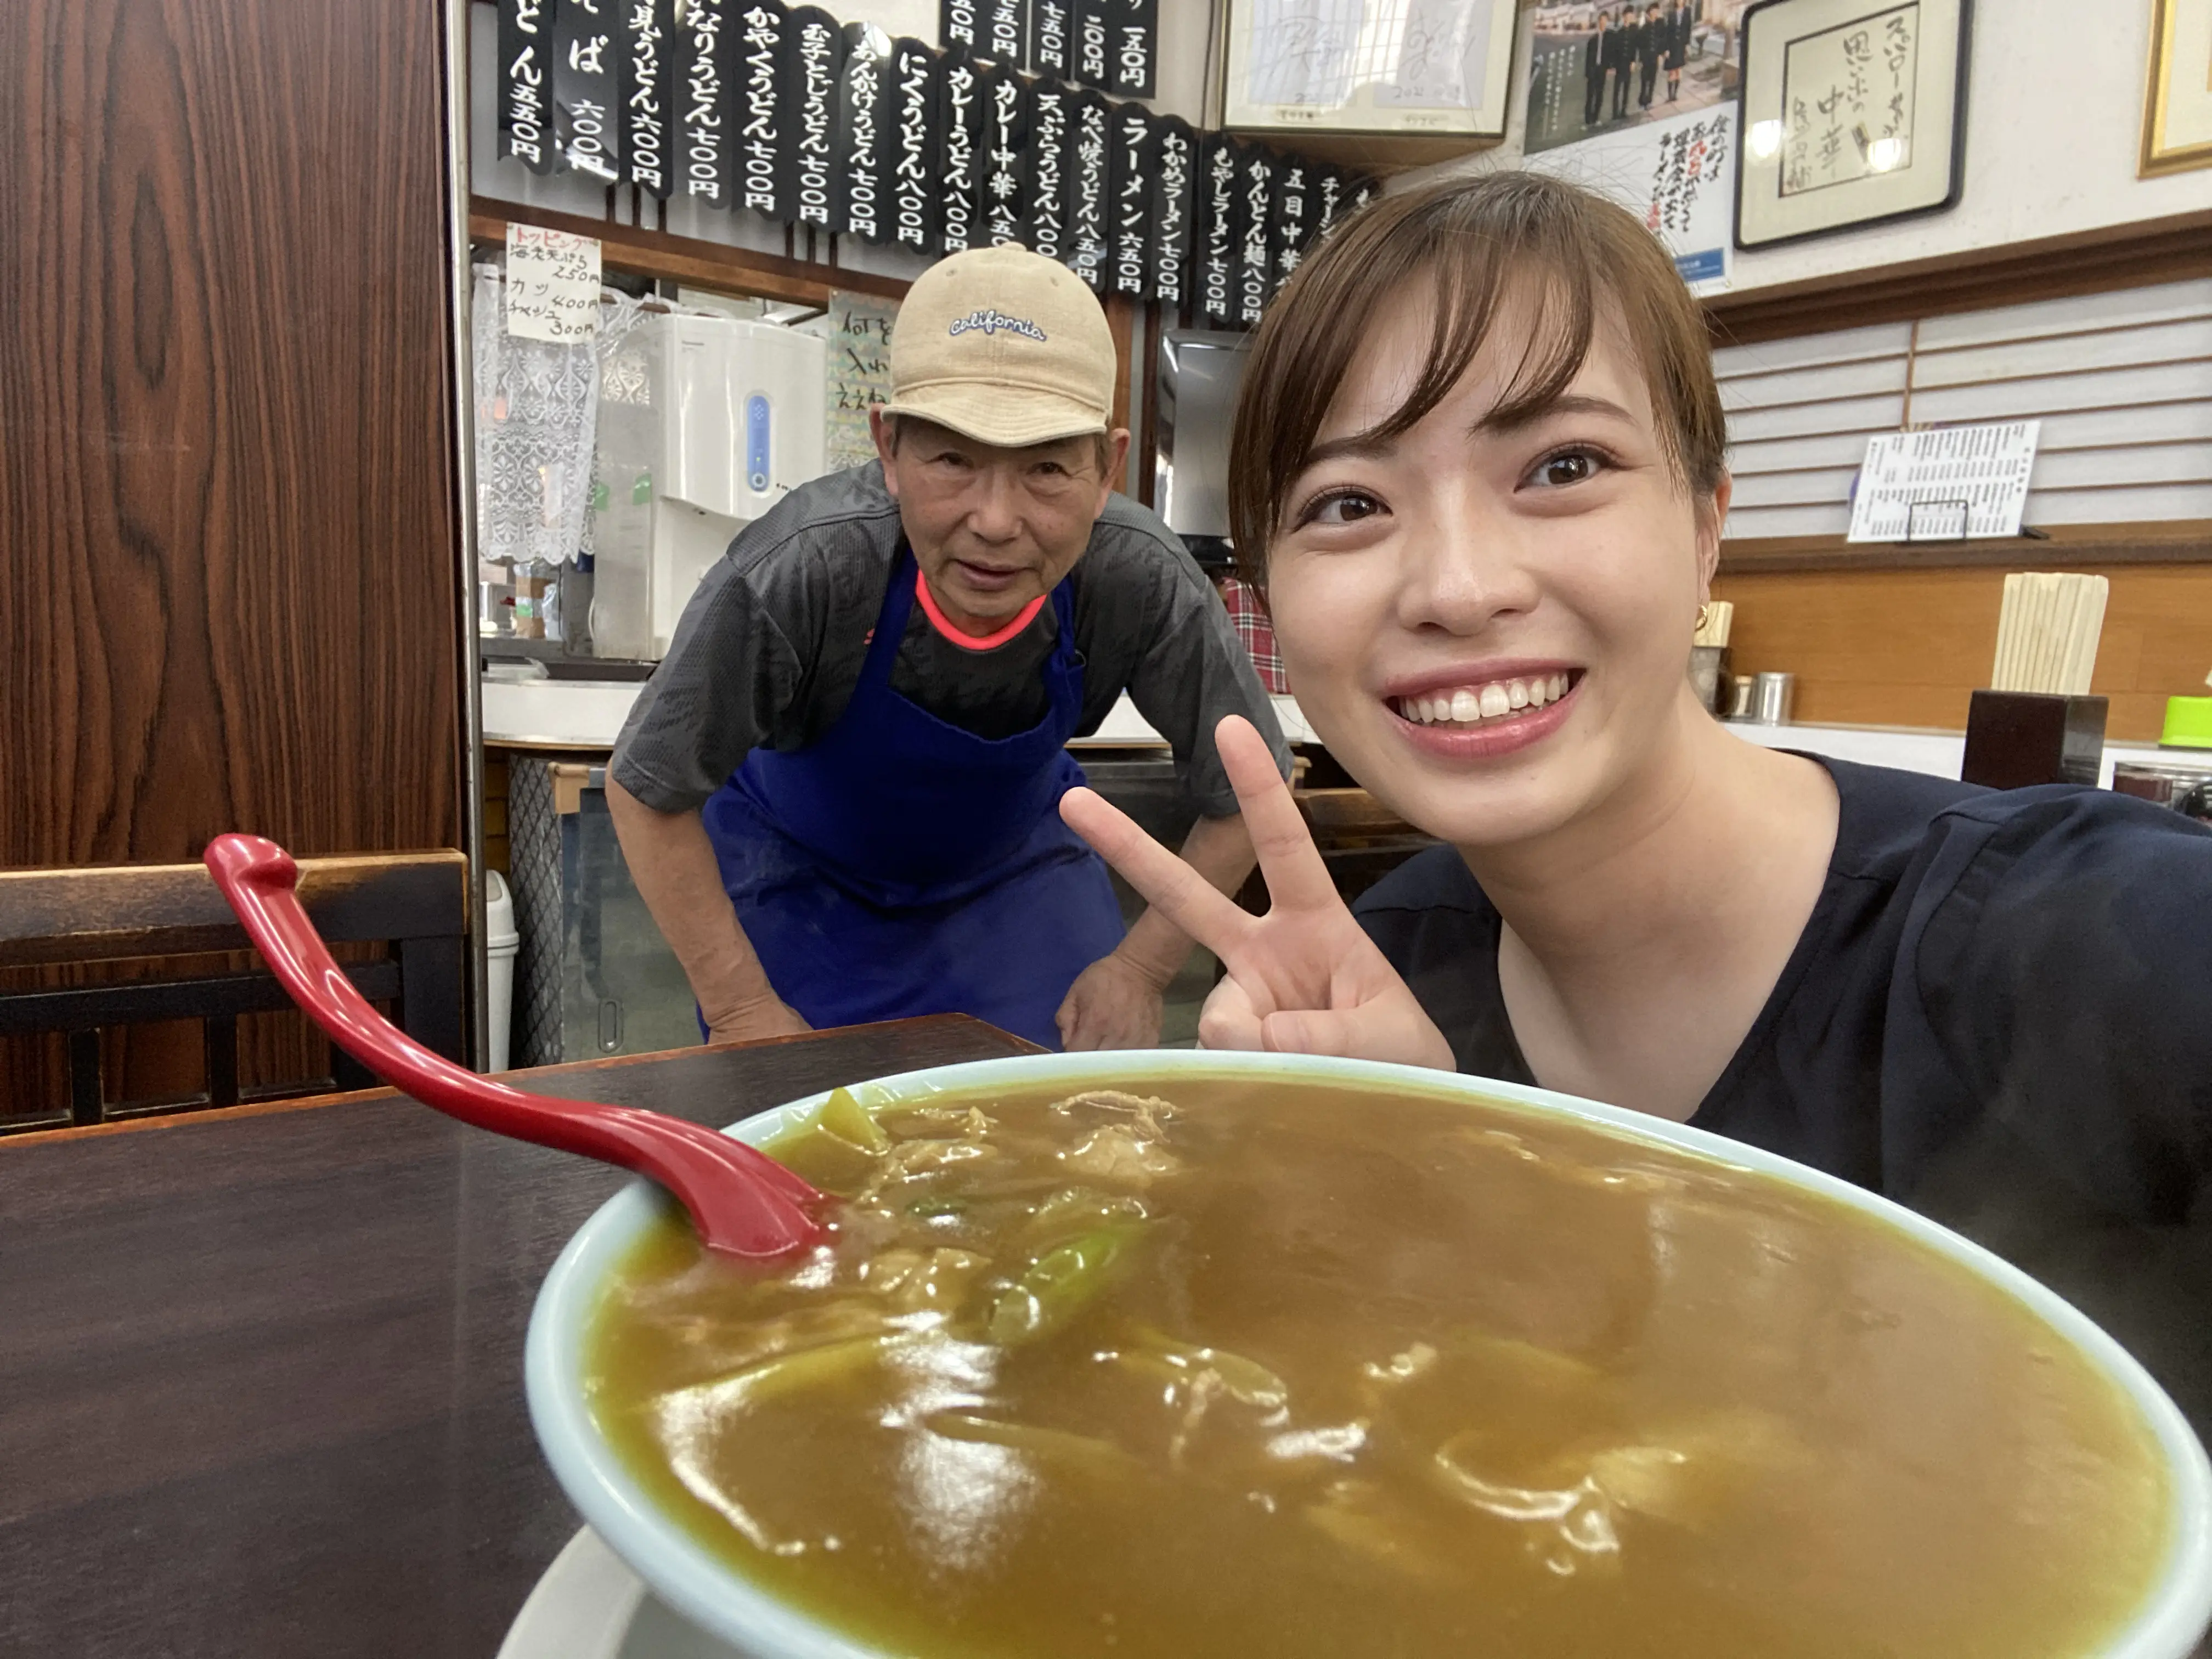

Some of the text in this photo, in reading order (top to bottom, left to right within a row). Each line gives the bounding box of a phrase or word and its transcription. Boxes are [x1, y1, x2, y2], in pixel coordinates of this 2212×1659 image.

[628, 0, 662, 188] 見うどん六〇〇円
[950, 309, 1047, 342] California
